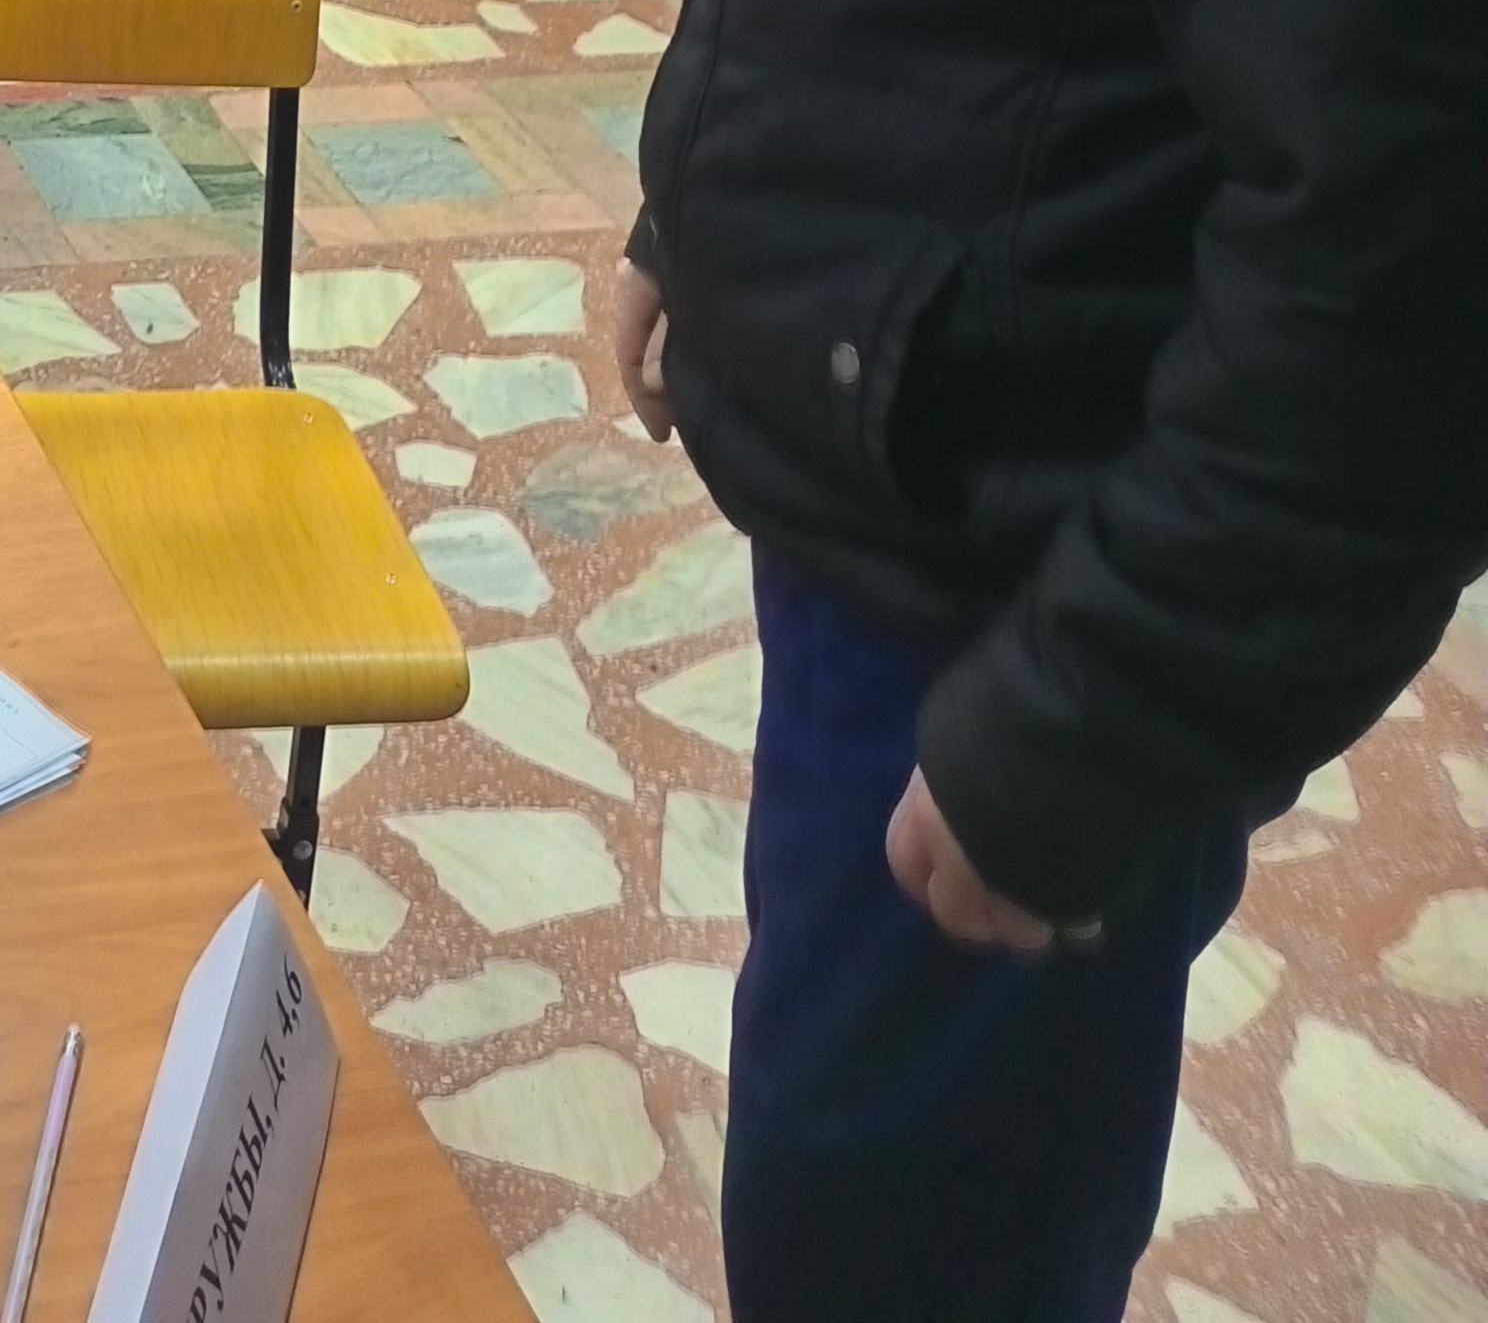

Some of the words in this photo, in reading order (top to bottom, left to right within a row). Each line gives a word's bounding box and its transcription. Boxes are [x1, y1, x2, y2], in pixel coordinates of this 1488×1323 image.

[187, 1094, 276, 1323] РУЖБЫ,
[260, 1035, 288, 1112] Д.
[276, 952, 304, 1039] 4,6
